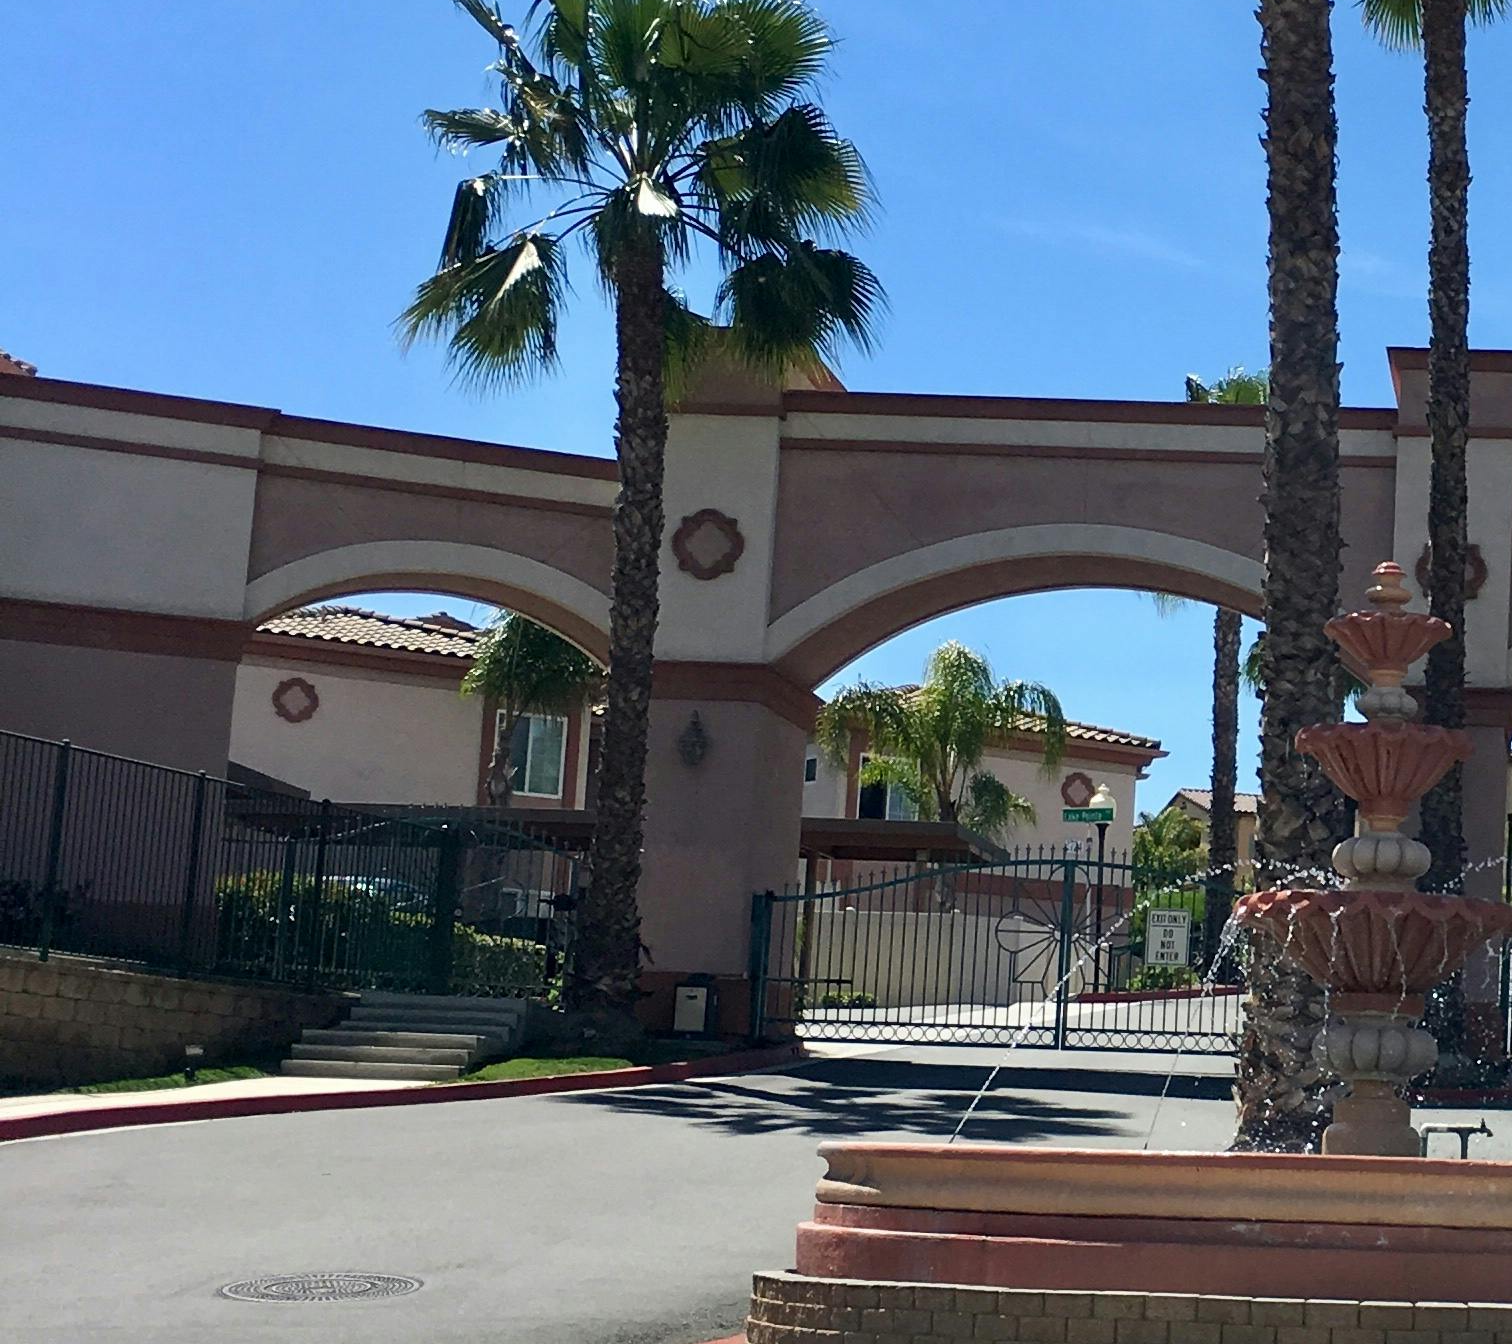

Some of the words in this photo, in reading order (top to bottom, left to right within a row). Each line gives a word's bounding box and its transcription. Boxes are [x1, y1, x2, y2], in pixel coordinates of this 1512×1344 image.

[1151, 914, 1166, 924] EXIT
[1168, 914, 1186, 925] ONLY
[1163, 928, 1174, 939] DO
[1160, 939, 1175, 950] NOT
[1155, 951, 1179, 961] ENTER
